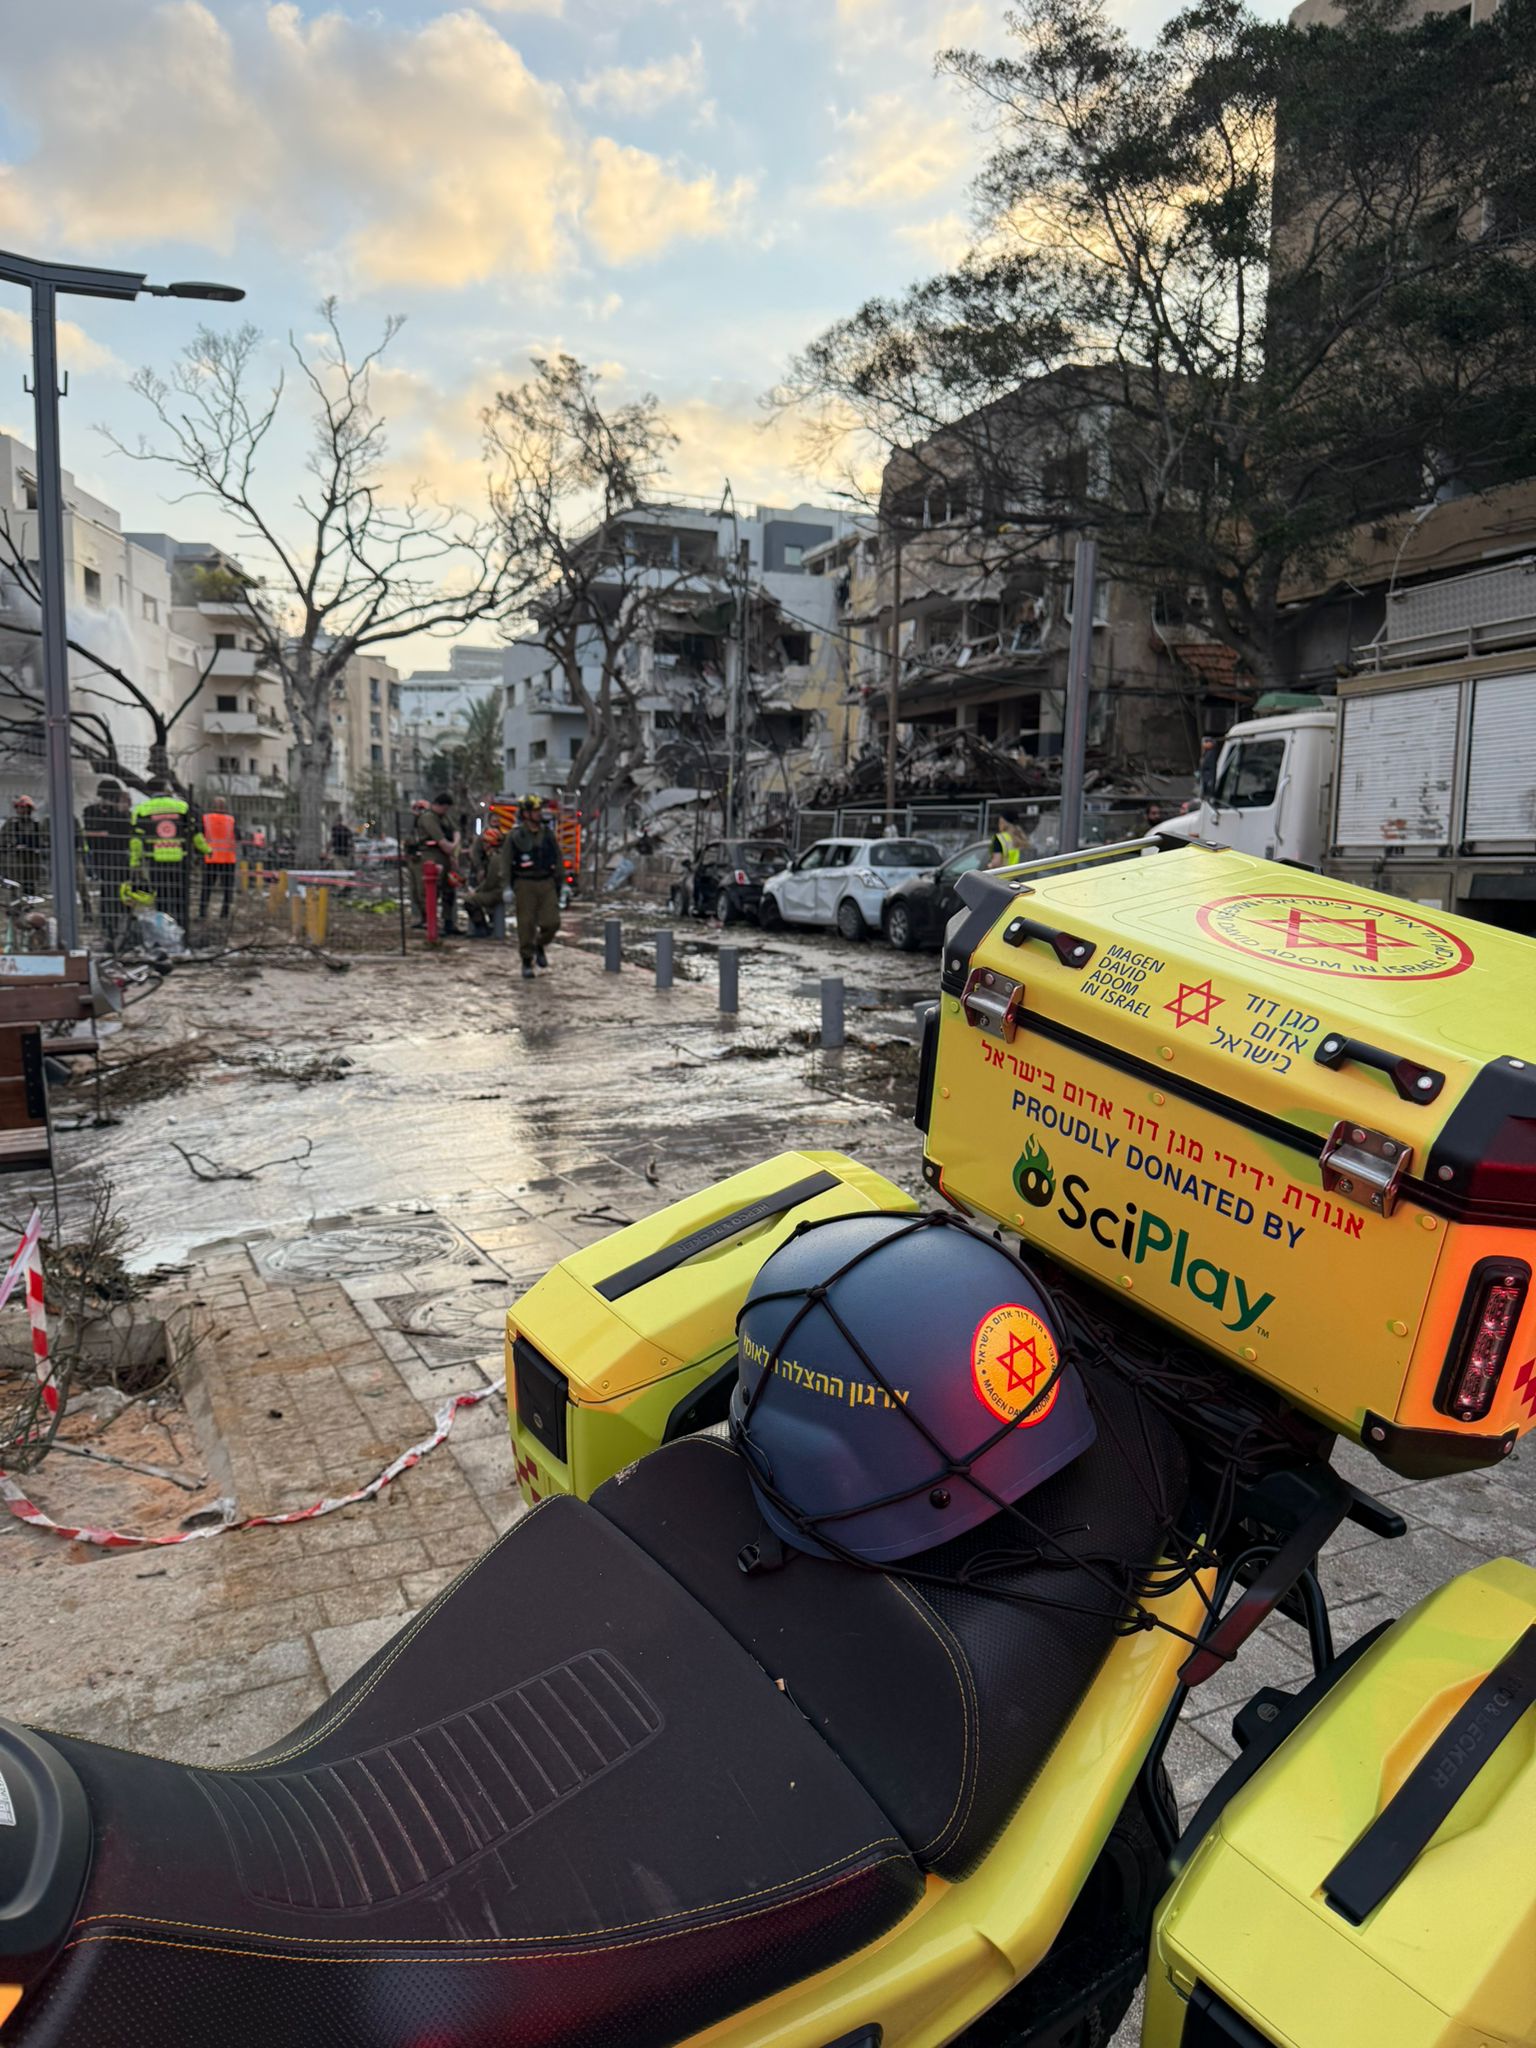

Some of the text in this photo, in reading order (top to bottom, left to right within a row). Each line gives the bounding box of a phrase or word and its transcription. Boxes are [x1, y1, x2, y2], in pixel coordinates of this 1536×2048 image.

[1363, 908, 1422, 929] אדם
[1107, 944, 1166, 974] MAGEN
[1217, 921, 1260, 947] DAVID
[1261, 948, 1341, 969] ADOM
[1352, 964, 1378, 974] IN
[1382, 959, 1448, 974] ISRAEL
[1089, 969, 1140, 996] ADOM
[1098, 956, 1147, 982] DAVID
[1080, 980, 1152, 1018] IN ISRAEL
[1246, 993, 1320, 1033] מגן דוד
[1209, 1025, 1292, 1075] בישראל
[1250, 1021, 1309, 1054] אדום
[981, 1039, 1366, 1241] אגודת ידידי מגן דוד אדום בישראל
[1012, 1089, 1306, 1249] PROUDLY DONATED BY
[1057, 1174, 1277, 1332] SciPlay
[976, 1310, 1044, 1366] מגן דוד אדום בישראל
[782, 1359, 845, 1400] ההצלה
[983, 1378, 1010, 1411] MAGEN
